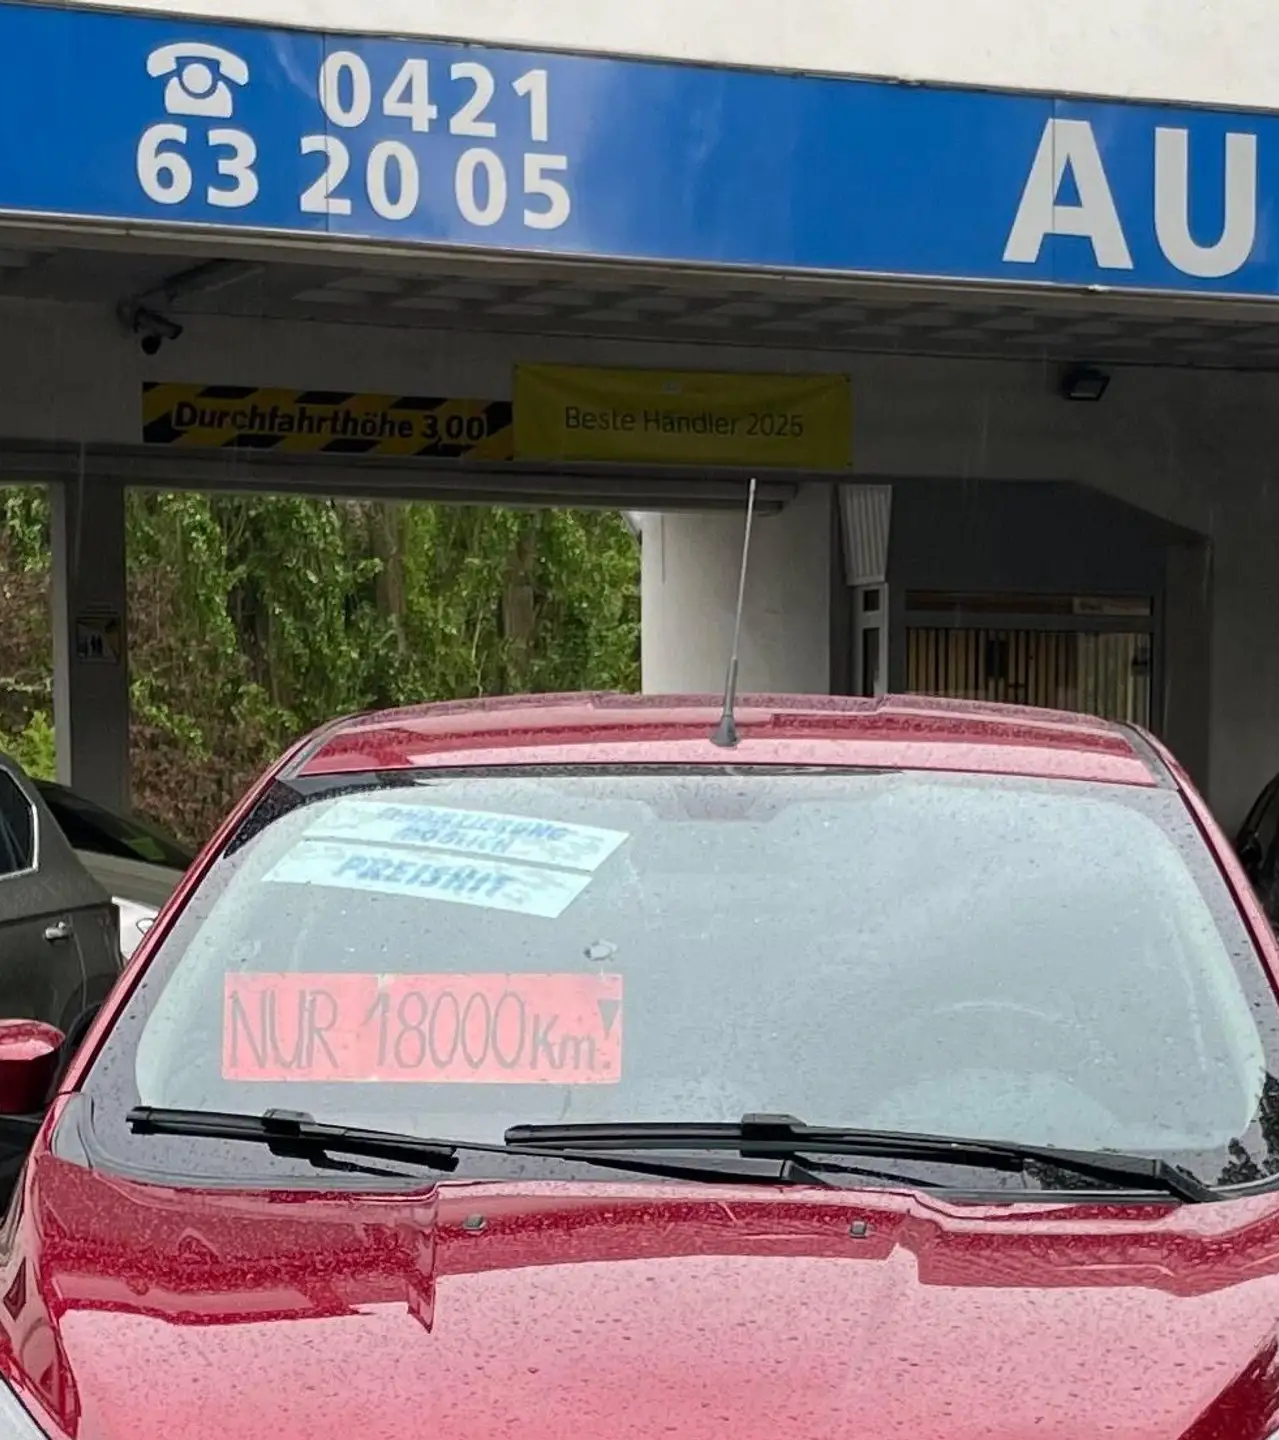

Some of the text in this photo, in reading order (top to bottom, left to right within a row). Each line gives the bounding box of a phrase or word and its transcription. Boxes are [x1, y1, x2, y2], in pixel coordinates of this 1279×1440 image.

[320, 51, 547, 141] 0421
[137, 123, 570, 229] 63 20 05
[173, 401, 413, 438] Durchfahrthöhe
[565, 406, 635, 431] Beste
[746, 412, 804, 437] 2025
[219, 989, 339, 1070] NUR
